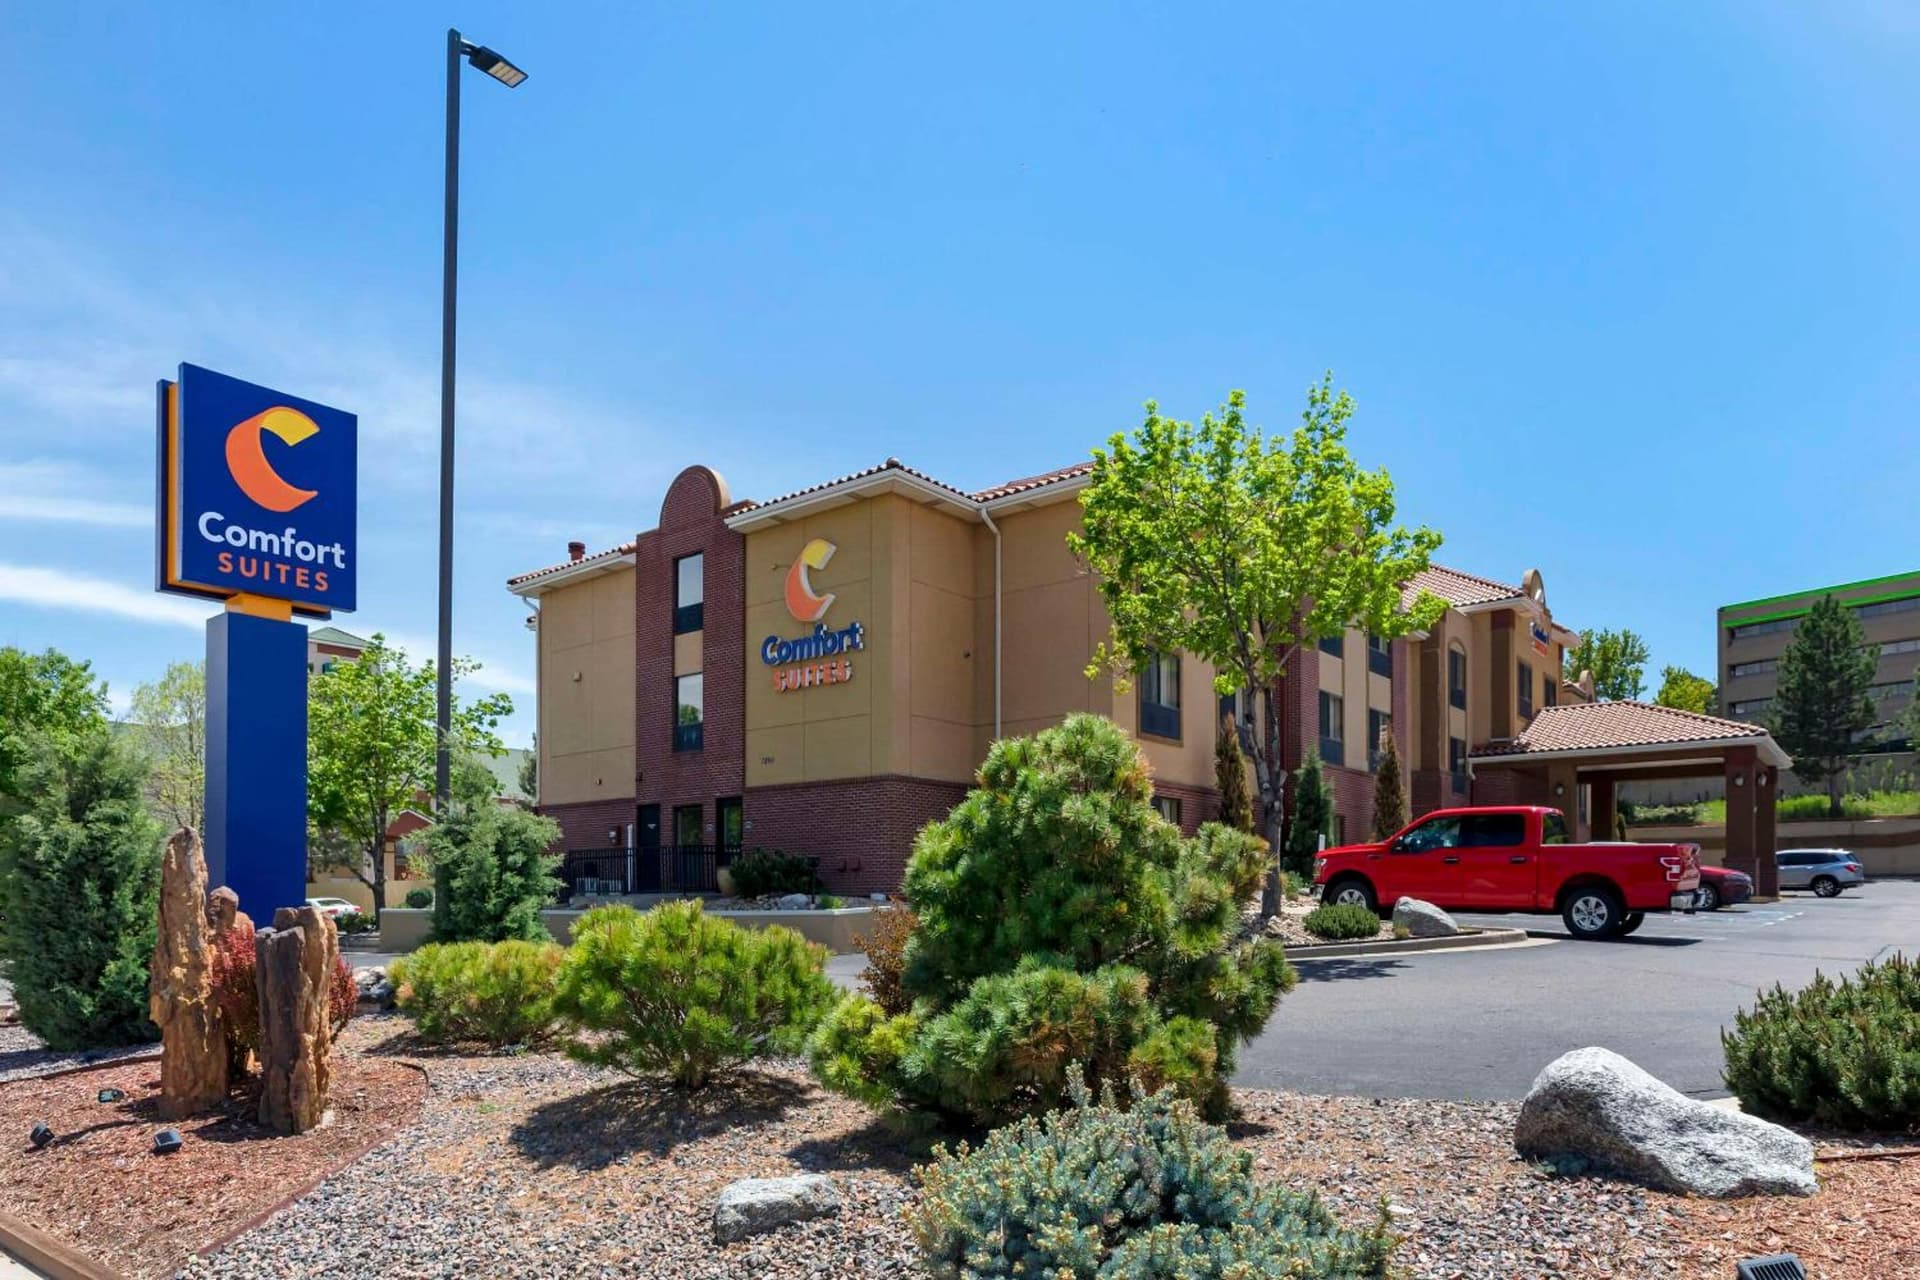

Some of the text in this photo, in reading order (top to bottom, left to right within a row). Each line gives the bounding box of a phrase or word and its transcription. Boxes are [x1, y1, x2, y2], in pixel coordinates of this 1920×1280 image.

[198, 511, 346, 569] Comfort
[217, 552, 329, 592] SUITES
[761, 622, 864, 666] Comfort
[772, 657, 852, 692] SUITES
